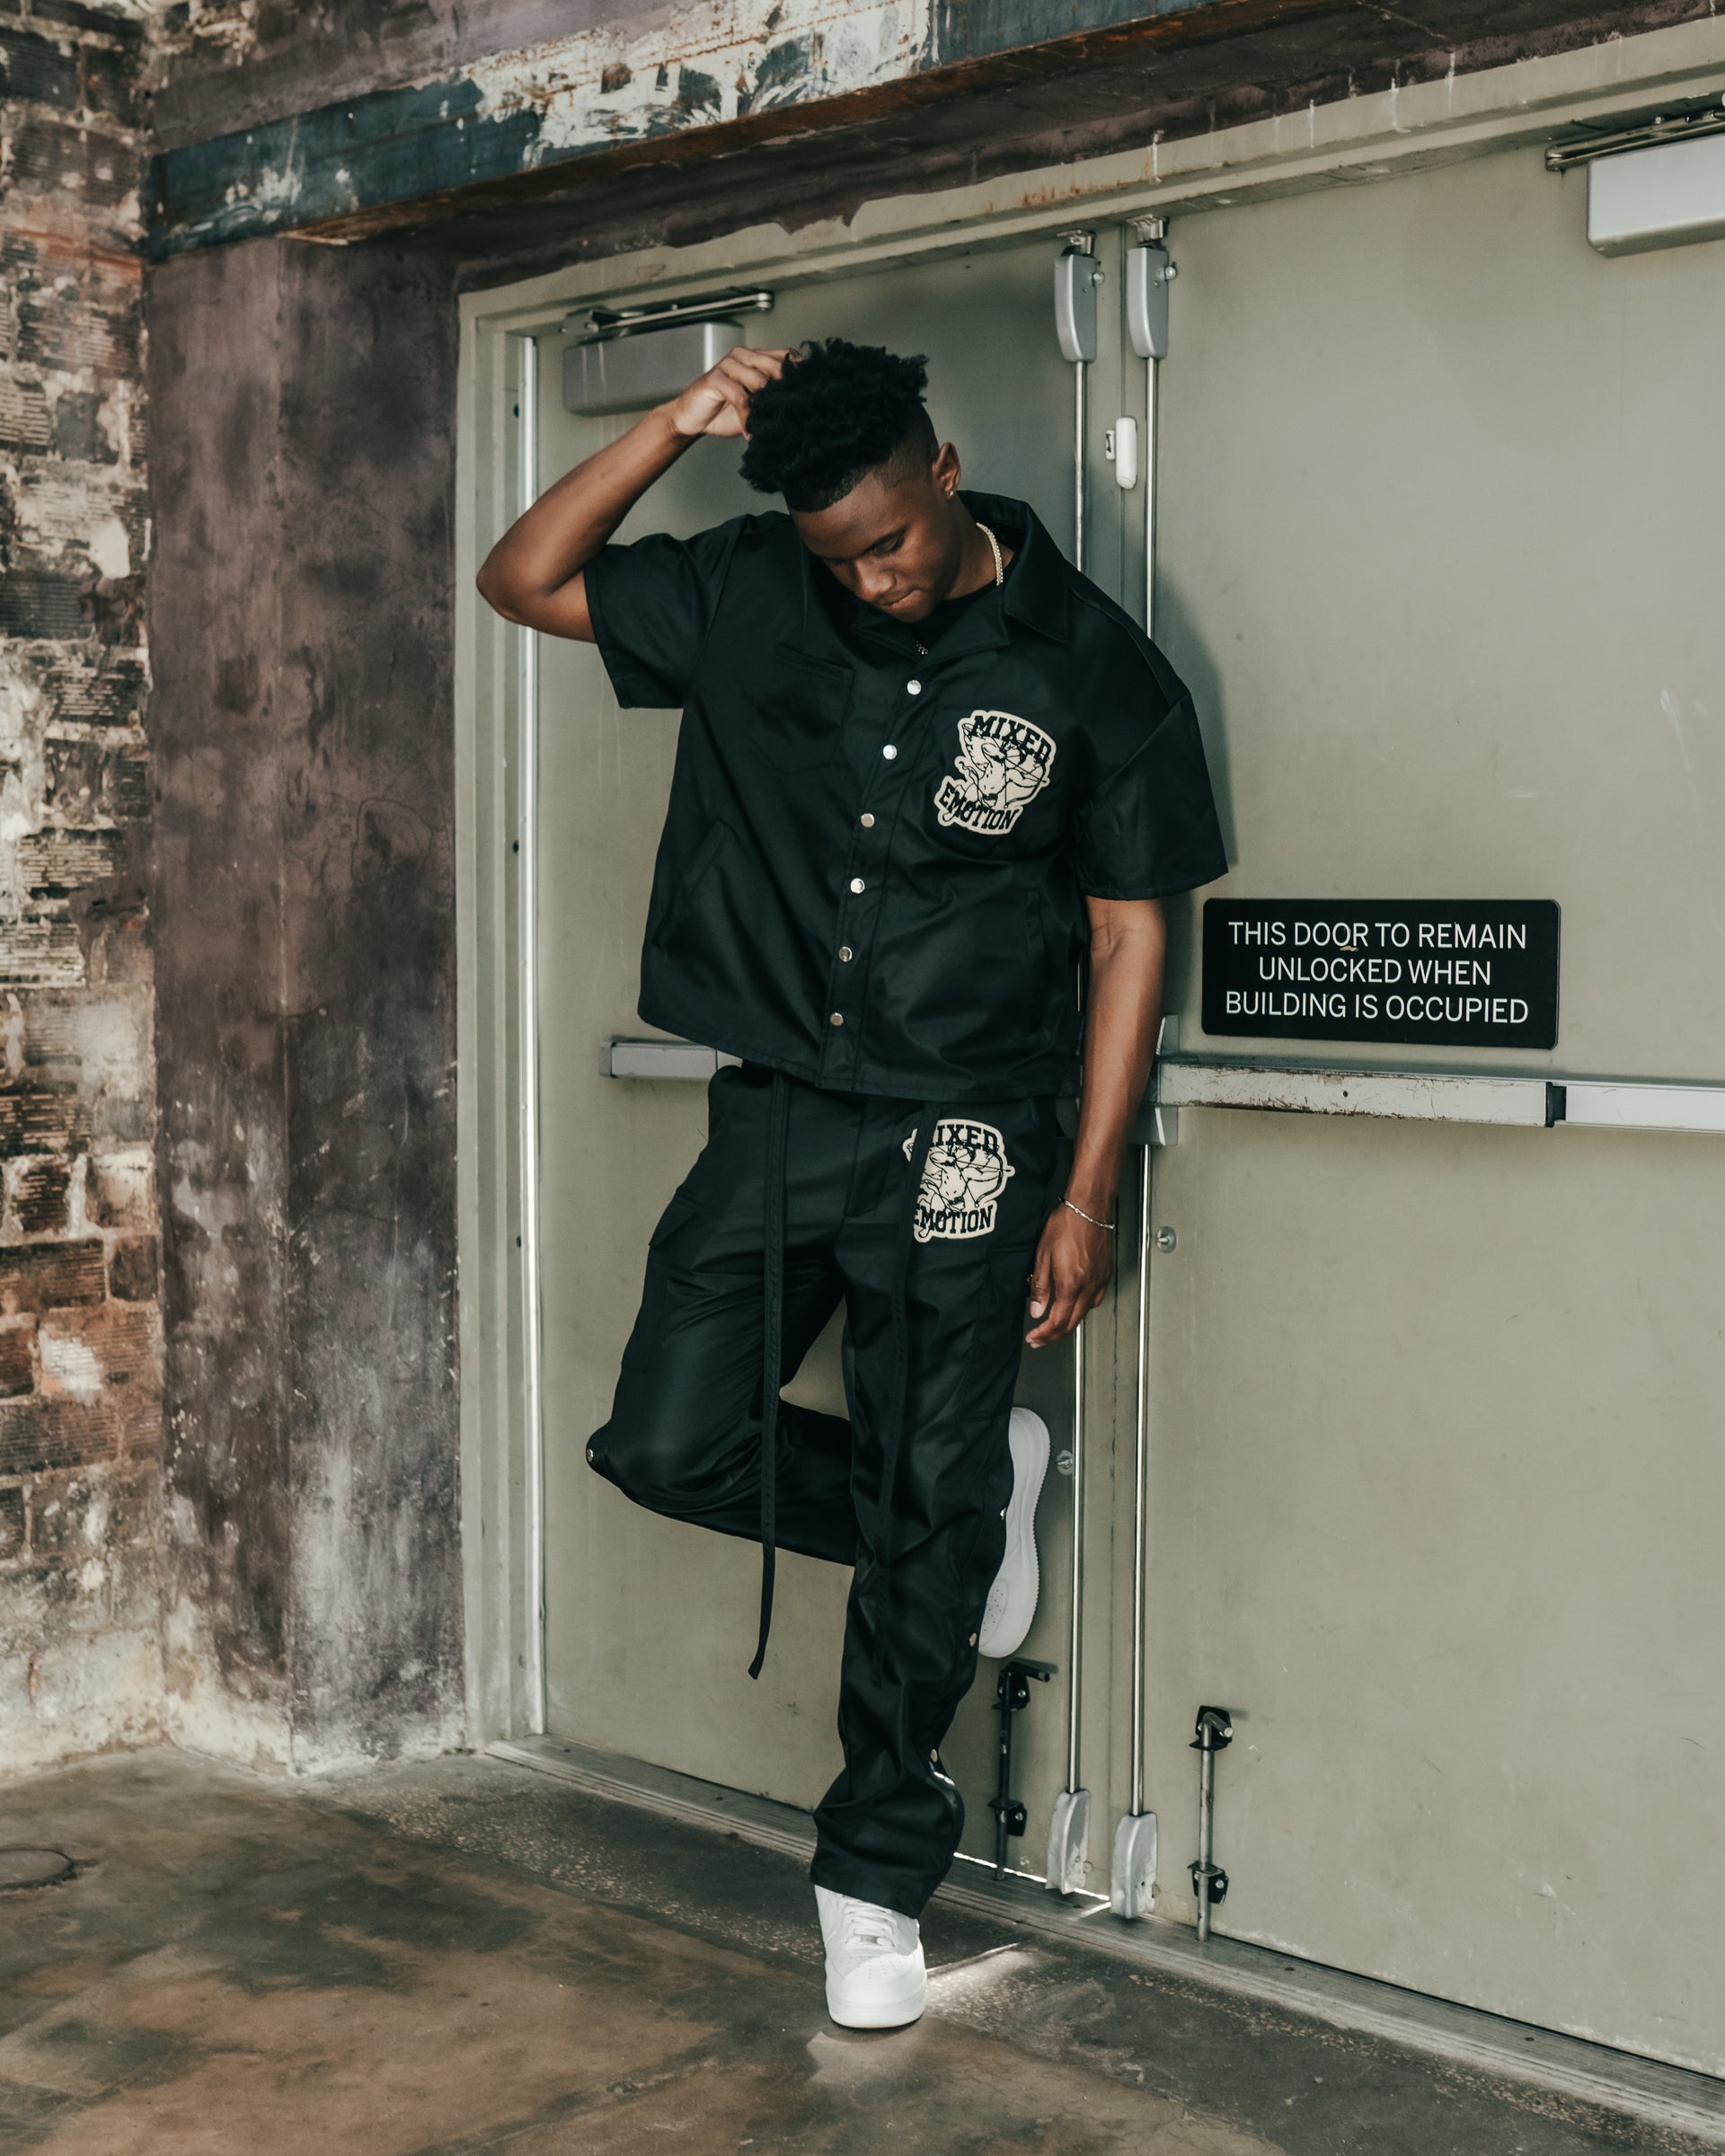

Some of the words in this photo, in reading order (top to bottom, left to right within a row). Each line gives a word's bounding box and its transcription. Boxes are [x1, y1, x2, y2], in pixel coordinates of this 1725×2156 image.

[968, 715, 1052, 765] MIXED
[939, 782, 1020, 830] EMOTION
[1228, 921, 1287, 946] THIS
[1294, 922, 1369, 947] DOOR
[1375, 922, 1411, 948] TO
[1419, 923, 1526, 950] REMAIN
[1259, 956, 1402, 984] UNLOCKED
[1408, 959, 1491, 986] WHEN
[1225, 990, 1347, 1019] BUILDING
[1355, 994, 1378, 1020] IS
[1385, 994, 1529, 1024] OCCUPIED
[933, 1124, 999, 1154] IXED
